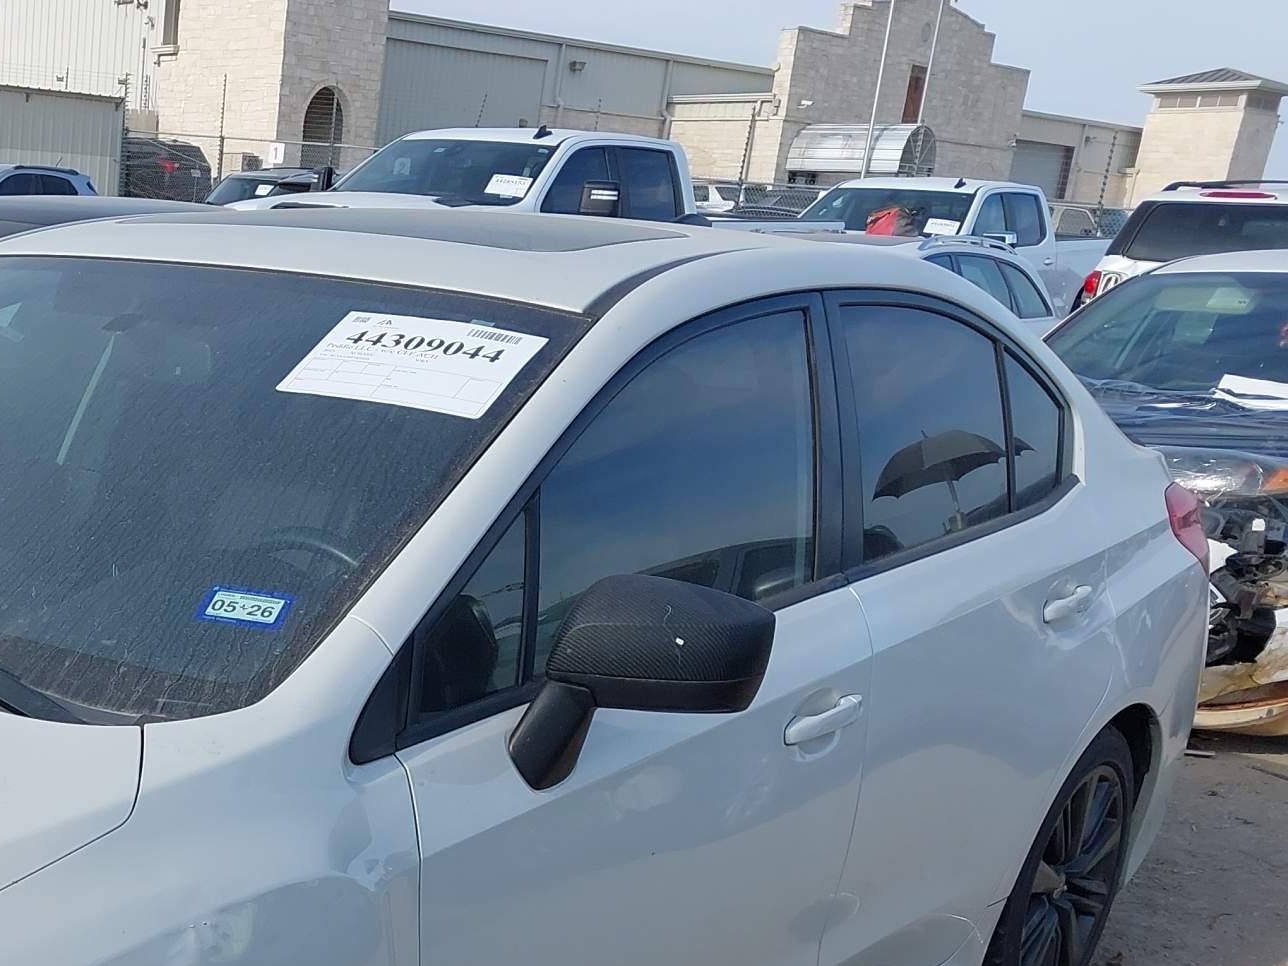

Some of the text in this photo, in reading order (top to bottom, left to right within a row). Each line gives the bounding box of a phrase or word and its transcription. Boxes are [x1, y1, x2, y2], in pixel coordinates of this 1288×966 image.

[345, 330, 505, 363] 44309044
[212, 599, 239, 613] 05
[246, 604, 275, 618] 26
